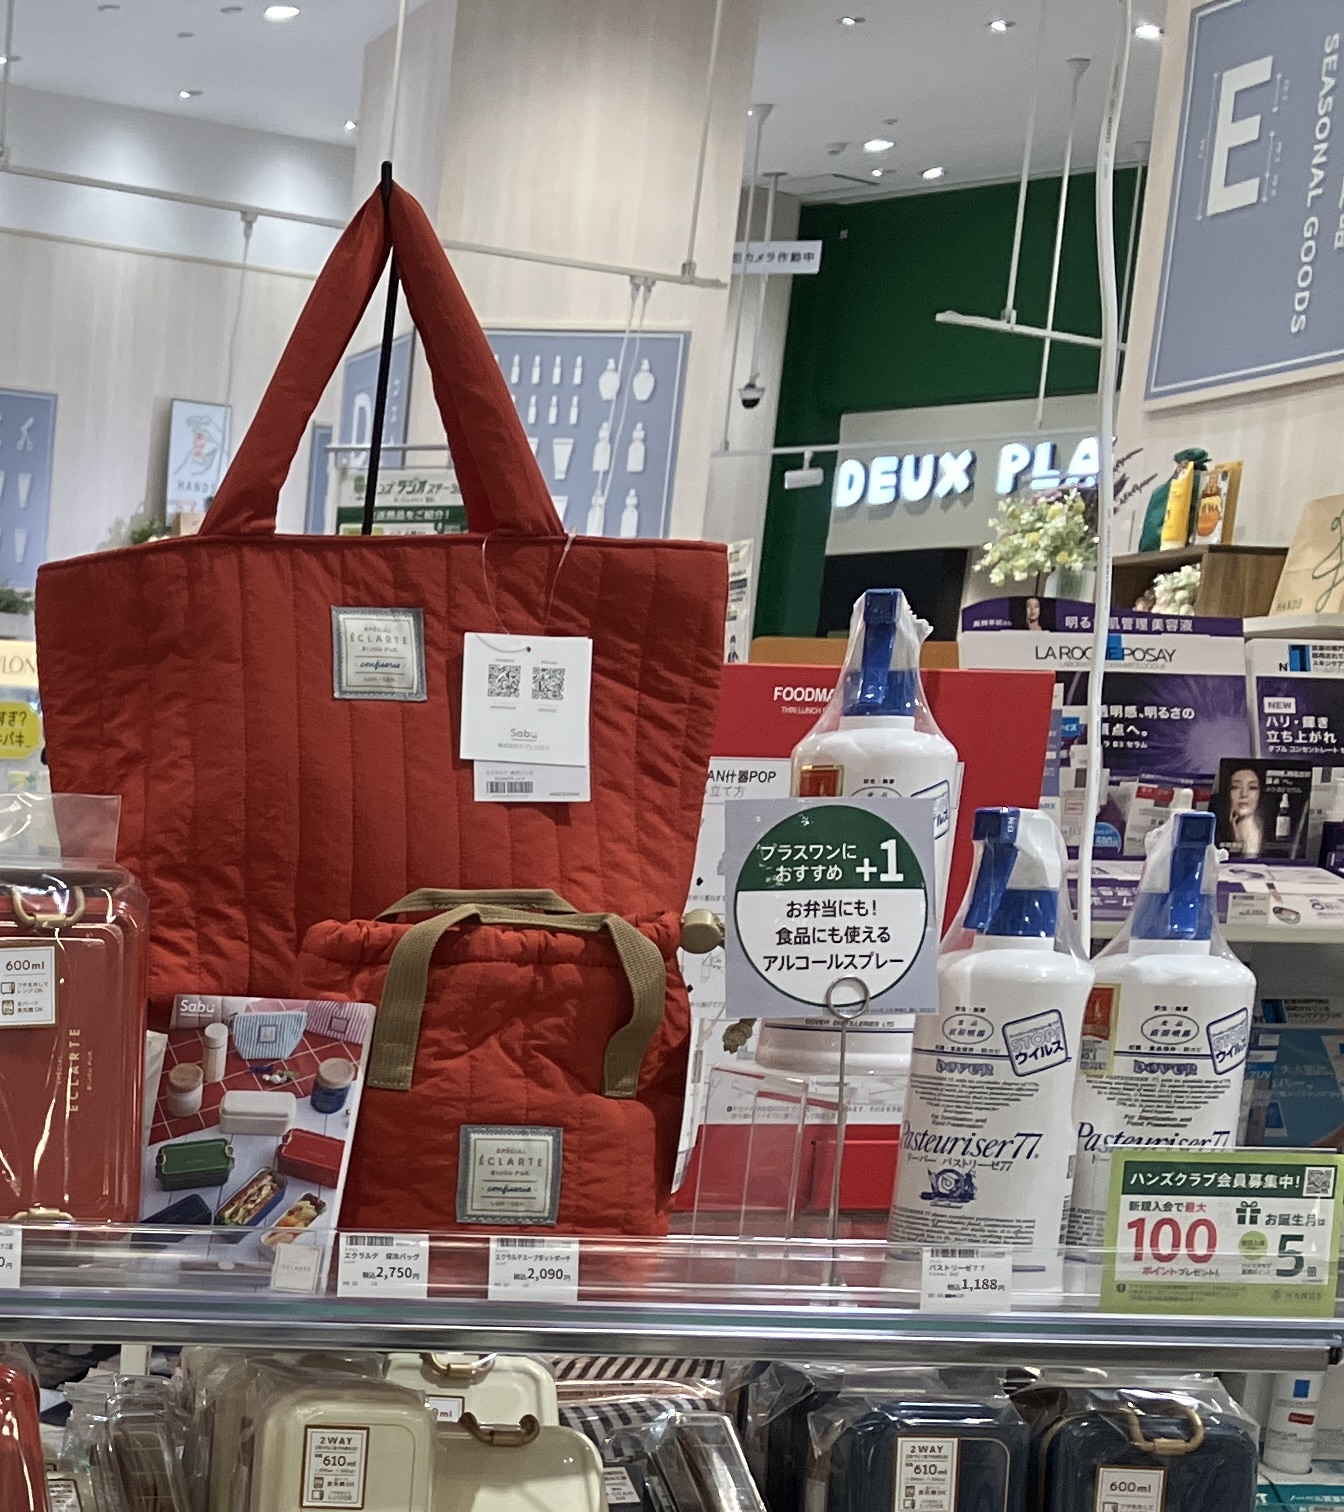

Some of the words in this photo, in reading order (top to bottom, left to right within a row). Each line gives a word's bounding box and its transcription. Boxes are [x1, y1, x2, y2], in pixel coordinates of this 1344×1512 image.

[1307, 33, 1340, 208] SEASONAL
[1206, 55, 1273, 216] E
[1290, 216, 1319, 334] GOODS
[835, 450, 977, 508] DEUX
[349, 632, 409, 645] ÉCLARTE
[1035, 645, 1056, 661] LA
[1059, 646, 1124, 661] ROCE
[773, 686, 837, 702] FOODMA
[1267, 700, 1293, 710] NEW
[759, 843, 858, 862] プラスワンに
[855, 838, 904, 883] +1
[775, 864, 843, 883] おすすめ
[775, 925, 892, 946] 食品にも使える
[5, 958, 47, 972] 600ml
[762, 952, 905, 973] アルコールスプレー
[179, 999, 217, 1015] Sabu
[1013, 1040, 1064, 1065] ウイルス
[478, 1155, 544, 1168] ÉCLARTE
[1128, 1200, 1208, 1214] 新規入会で最大
[1127, 1217, 1218, 1264] 100
[362, 1266, 421, 1281] 税込2,750円
[946, 1277, 1006, 1295] 税込1,188円
[320, 1435, 354, 1446] 2WAY
[909, 1444, 945, 1454] 2WAY
[322, 1453, 357, 1469] 610ml
[1109, 1479, 1153, 1494] 600ml
